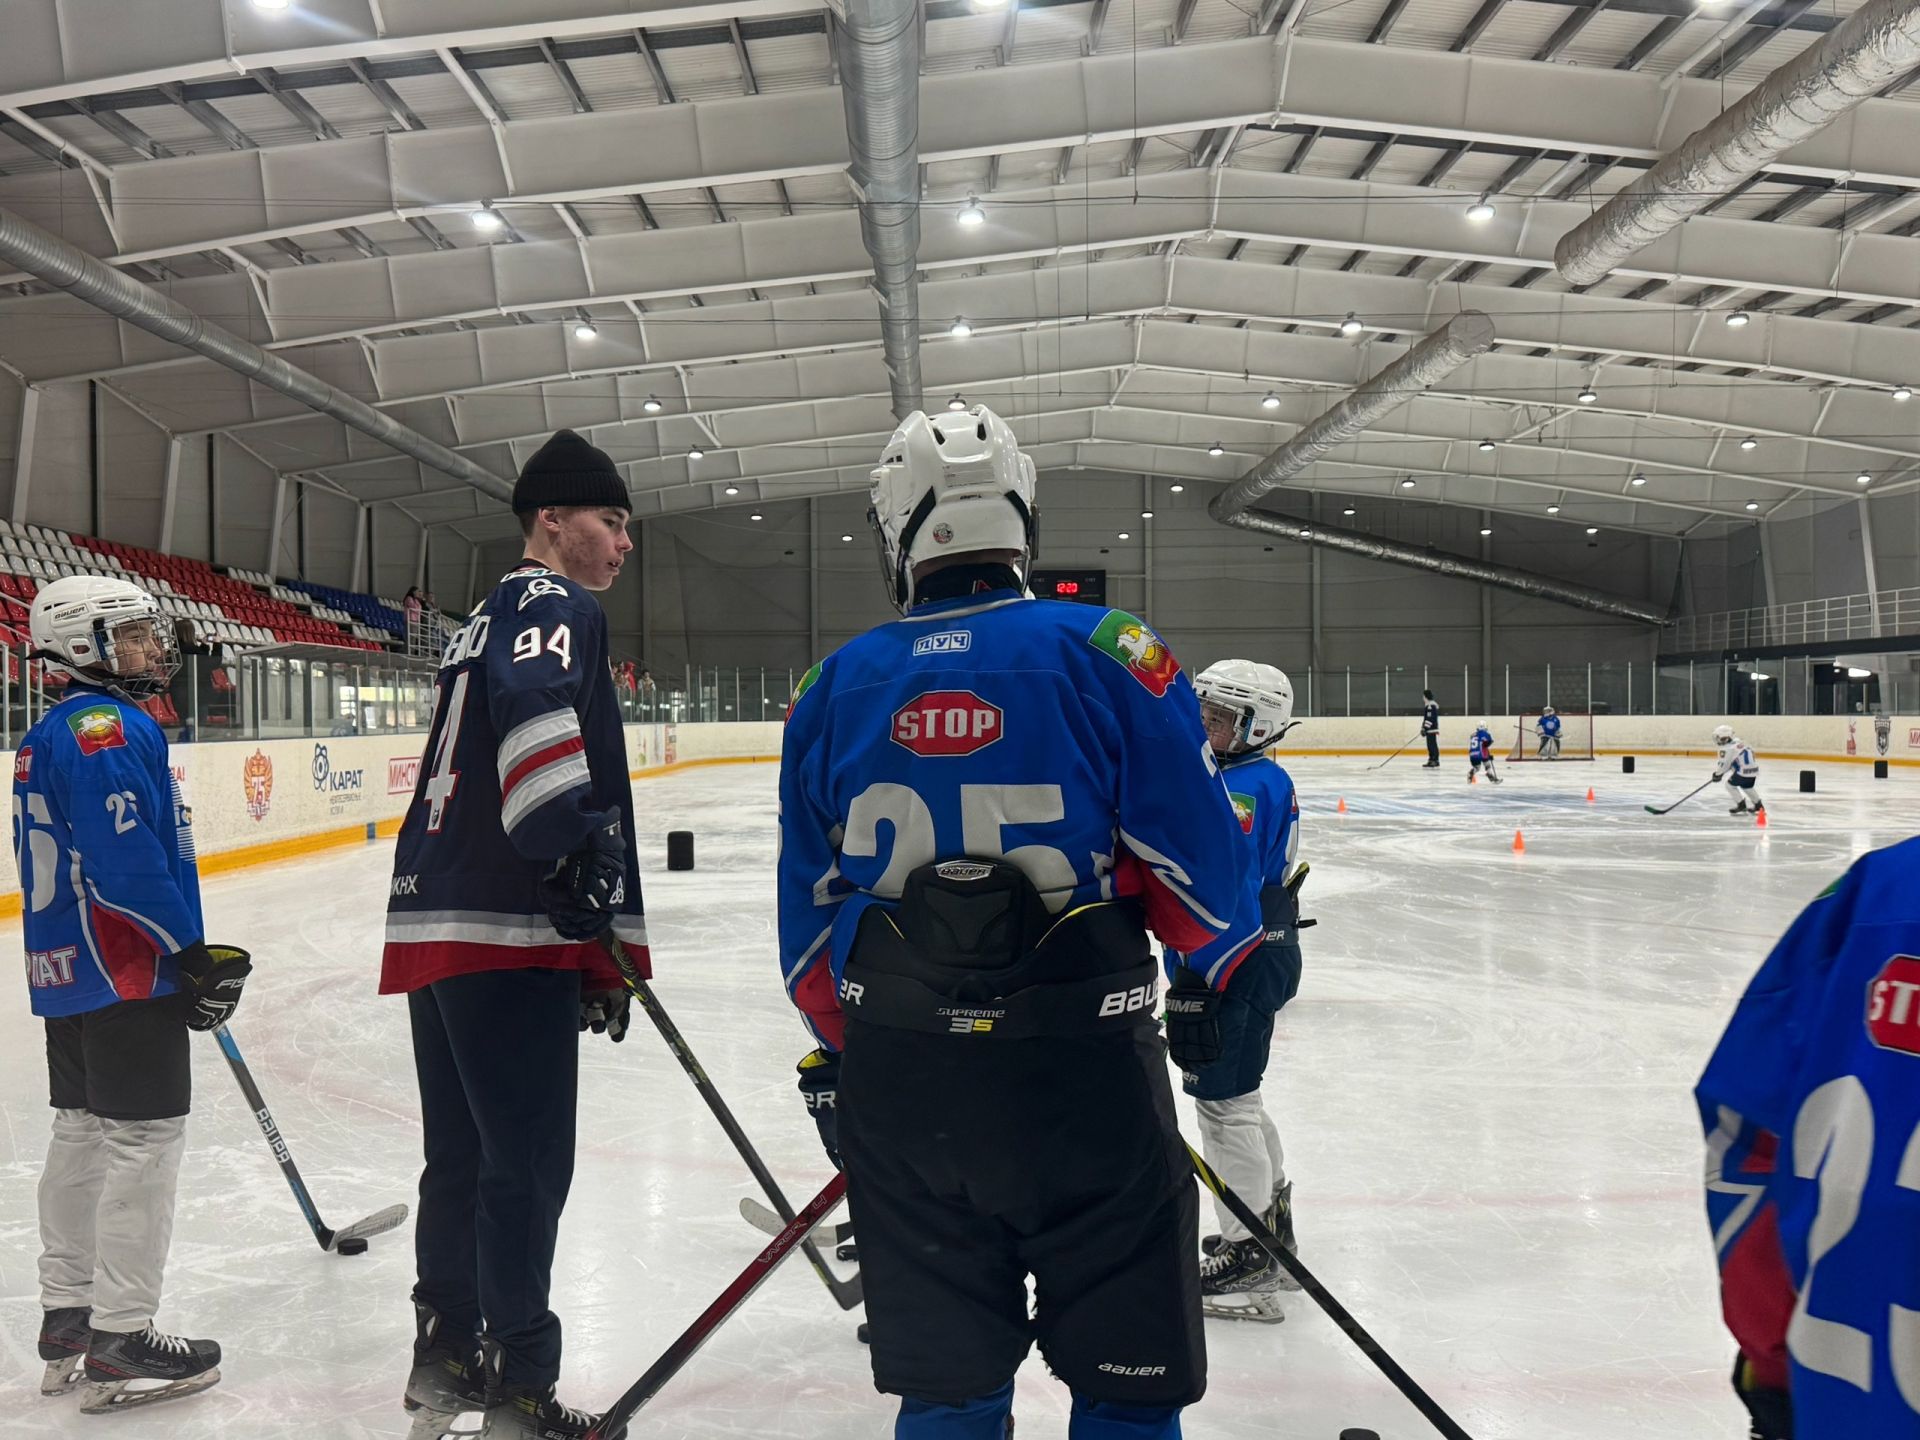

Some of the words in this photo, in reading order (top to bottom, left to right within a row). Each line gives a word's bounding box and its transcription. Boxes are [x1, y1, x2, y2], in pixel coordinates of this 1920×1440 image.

[513, 623, 572, 671] 94
[898, 707, 995, 740] STOP
[415, 671, 469, 831] 4
[330, 769, 363, 791] КАРАТ
[842, 782, 1078, 914] 25
[389, 874, 418, 896] КНХ
[1261, 930, 1285, 941] ER
[936, 1007, 1005, 1018] SUPREME
[1099, 976, 1159, 1017] BAU
[1869, 980, 1920, 1028] ST
[256, 1107, 291, 1164] BAUER
[1785, 1074, 1920, 1415] 2
[1097, 1362, 1167, 1376] BAUER
